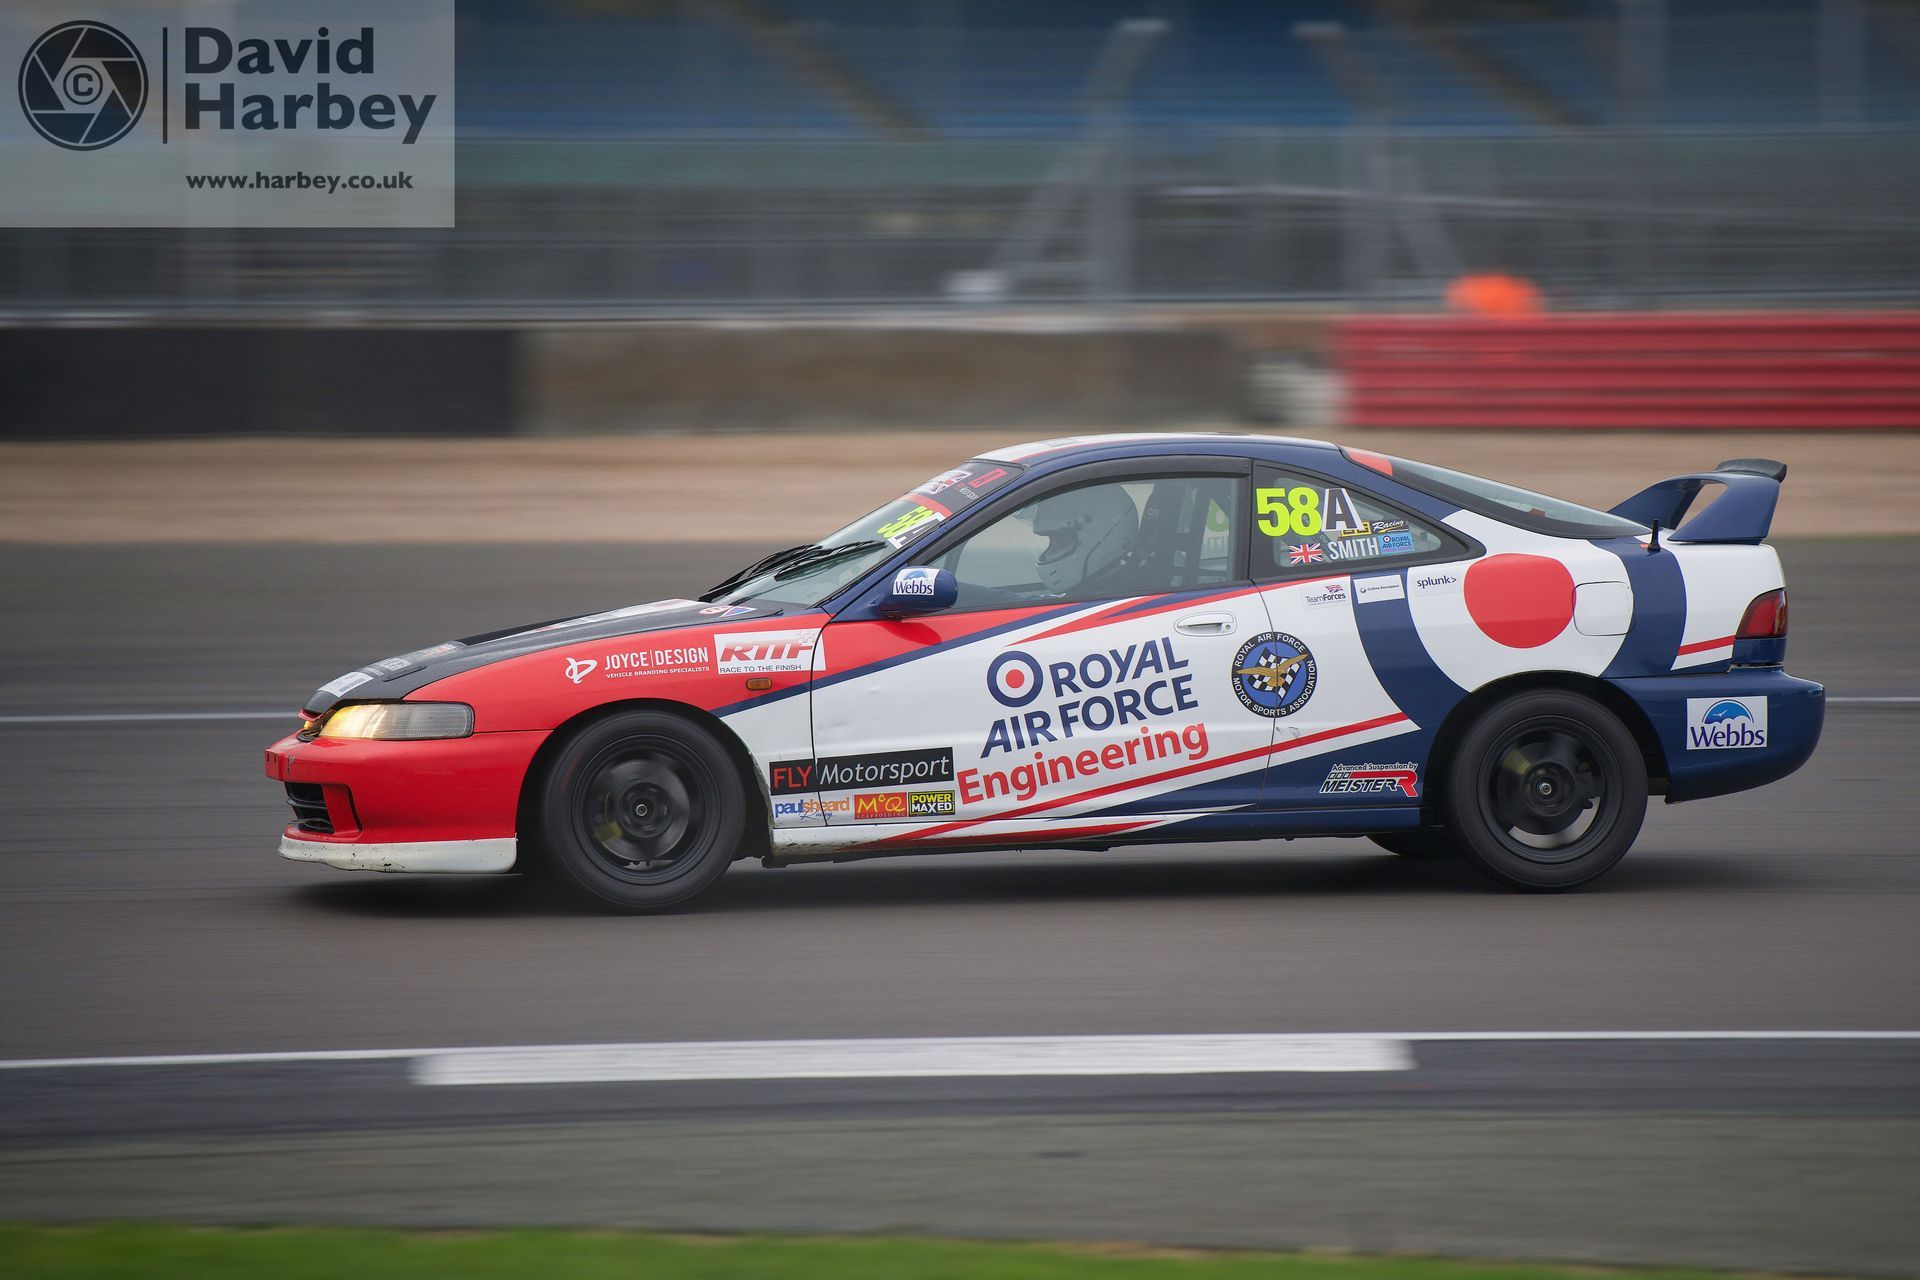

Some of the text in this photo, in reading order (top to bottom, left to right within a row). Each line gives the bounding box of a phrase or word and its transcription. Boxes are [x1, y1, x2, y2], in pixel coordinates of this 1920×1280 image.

[1372, 520, 1405, 532] Racing
[1328, 537, 1380, 560] SMITH
[1393, 541, 1412, 549] FORCE
[895, 578, 933, 595] Webbs
[1235, 633, 1305, 667] ROYAL AIR FORCE
[1049, 637, 1189, 697] ROYAL
[1233, 659, 1316, 717] MOTOR SPORTS ASSOCIATION
[980, 674, 1198, 759] AIR FORCE
[1691, 723, 1765, 747] Webbs
[773, 756, 949, 789] FLY Motorsport
[957, 722, 1209, 805] Engineering
[1332, 761, 1419, 771] Advanced Suspension by
[911, 793, 951, 804] POWER
[911, 802, 952, 814] MAXED
